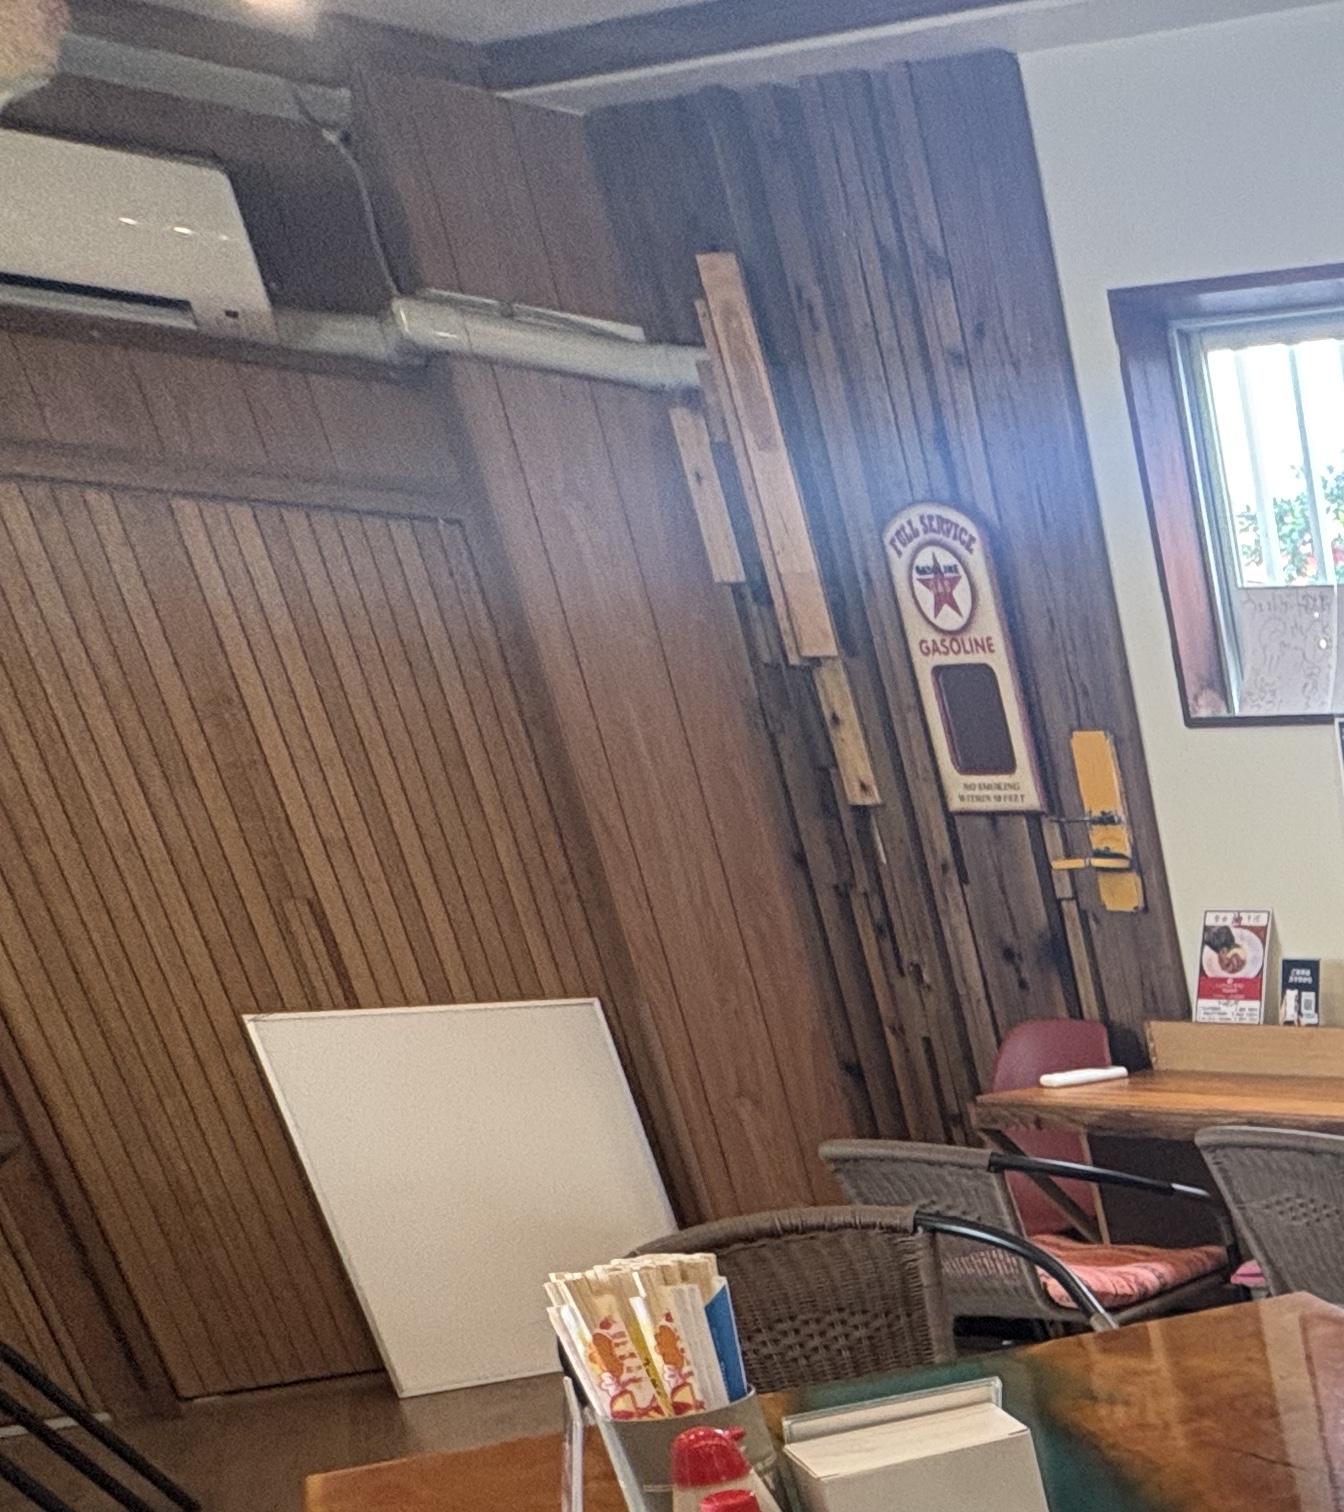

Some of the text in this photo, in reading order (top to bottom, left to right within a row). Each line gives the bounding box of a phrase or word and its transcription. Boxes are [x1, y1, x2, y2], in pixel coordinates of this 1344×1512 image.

[889, 513, 978, 559] FULL SERVICE
[918, 636, 996, 657] GASOLINE
